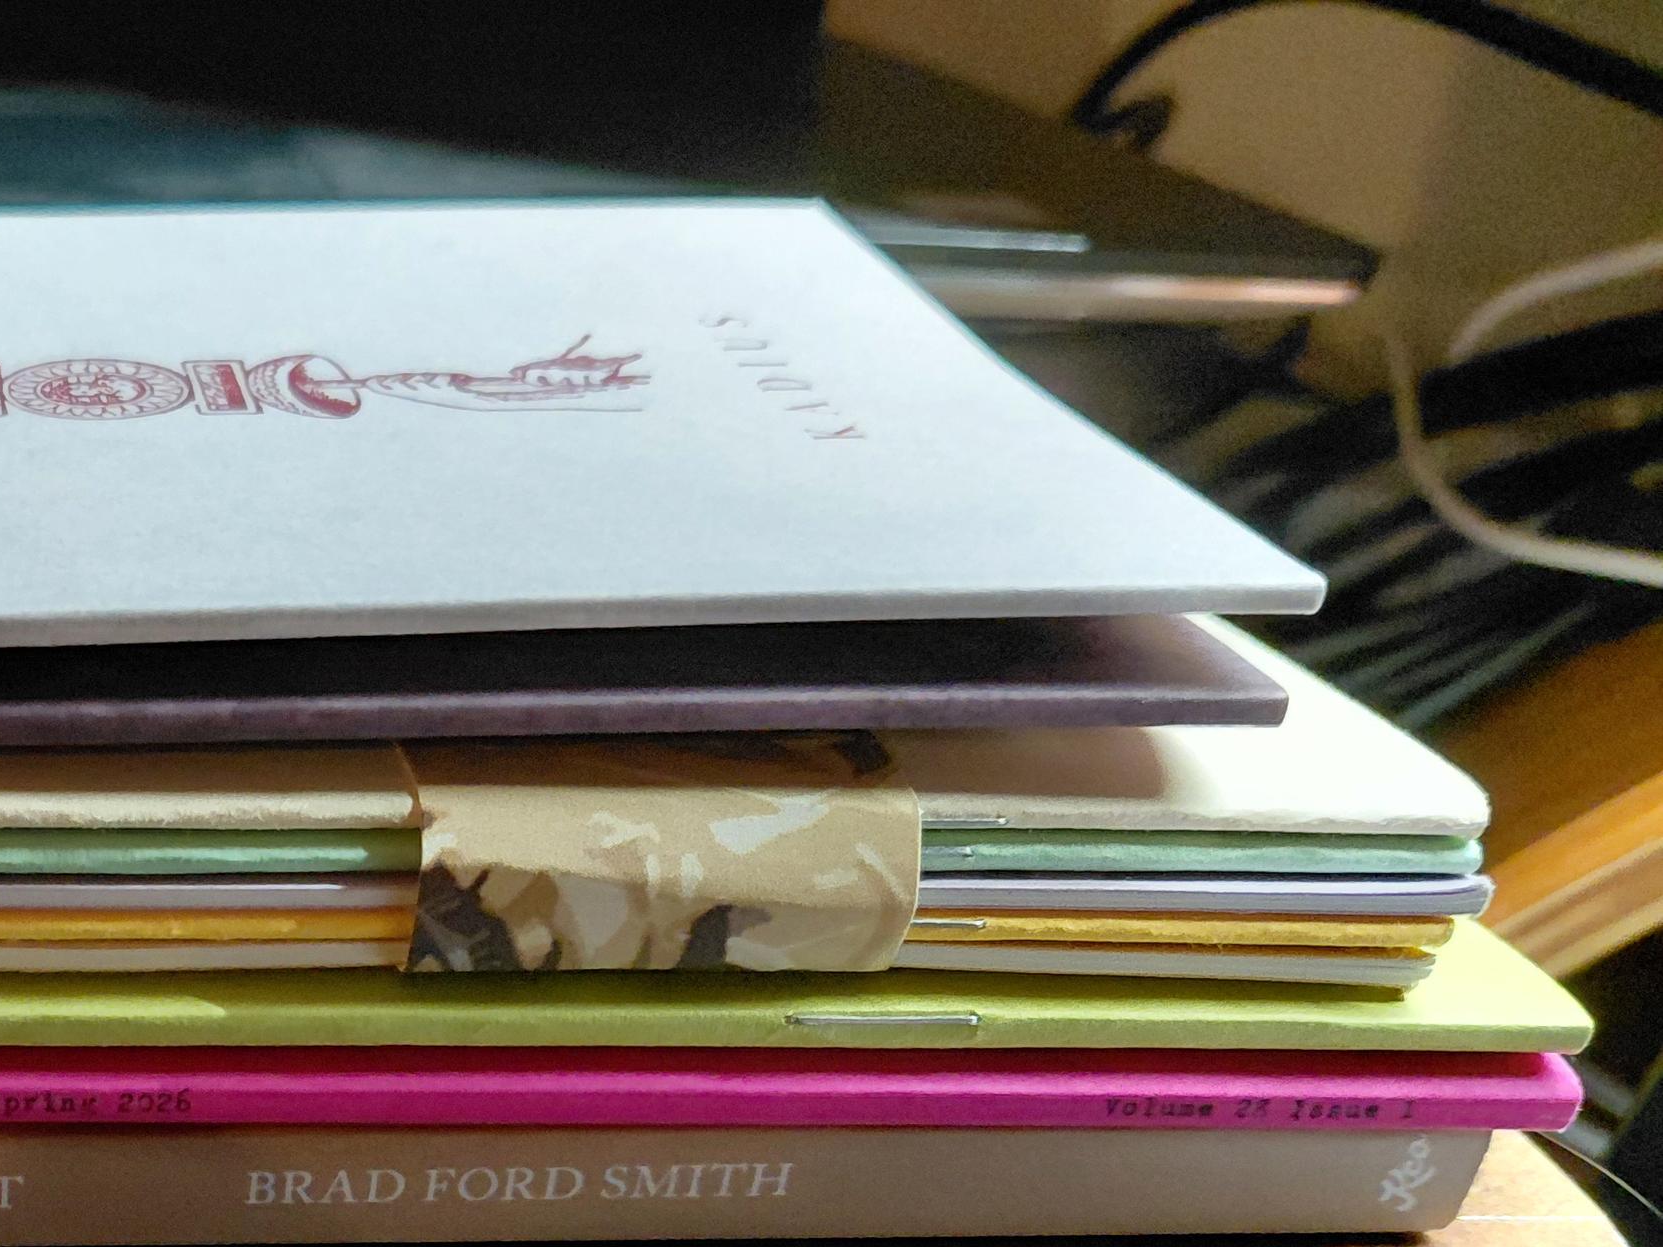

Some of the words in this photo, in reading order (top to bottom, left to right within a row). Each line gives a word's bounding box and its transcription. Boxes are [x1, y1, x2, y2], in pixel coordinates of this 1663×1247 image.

[698, 316, 868, 441] KADIUS
[117, 1088, 192, 1114] 2026
[1105, 1097, 1214, 1118] Volume
[244, 1168, 407, 1205] BRAD
[423, 1164, 585, 1203] FORD
[600, 1162, 795, 1200] SMITH
